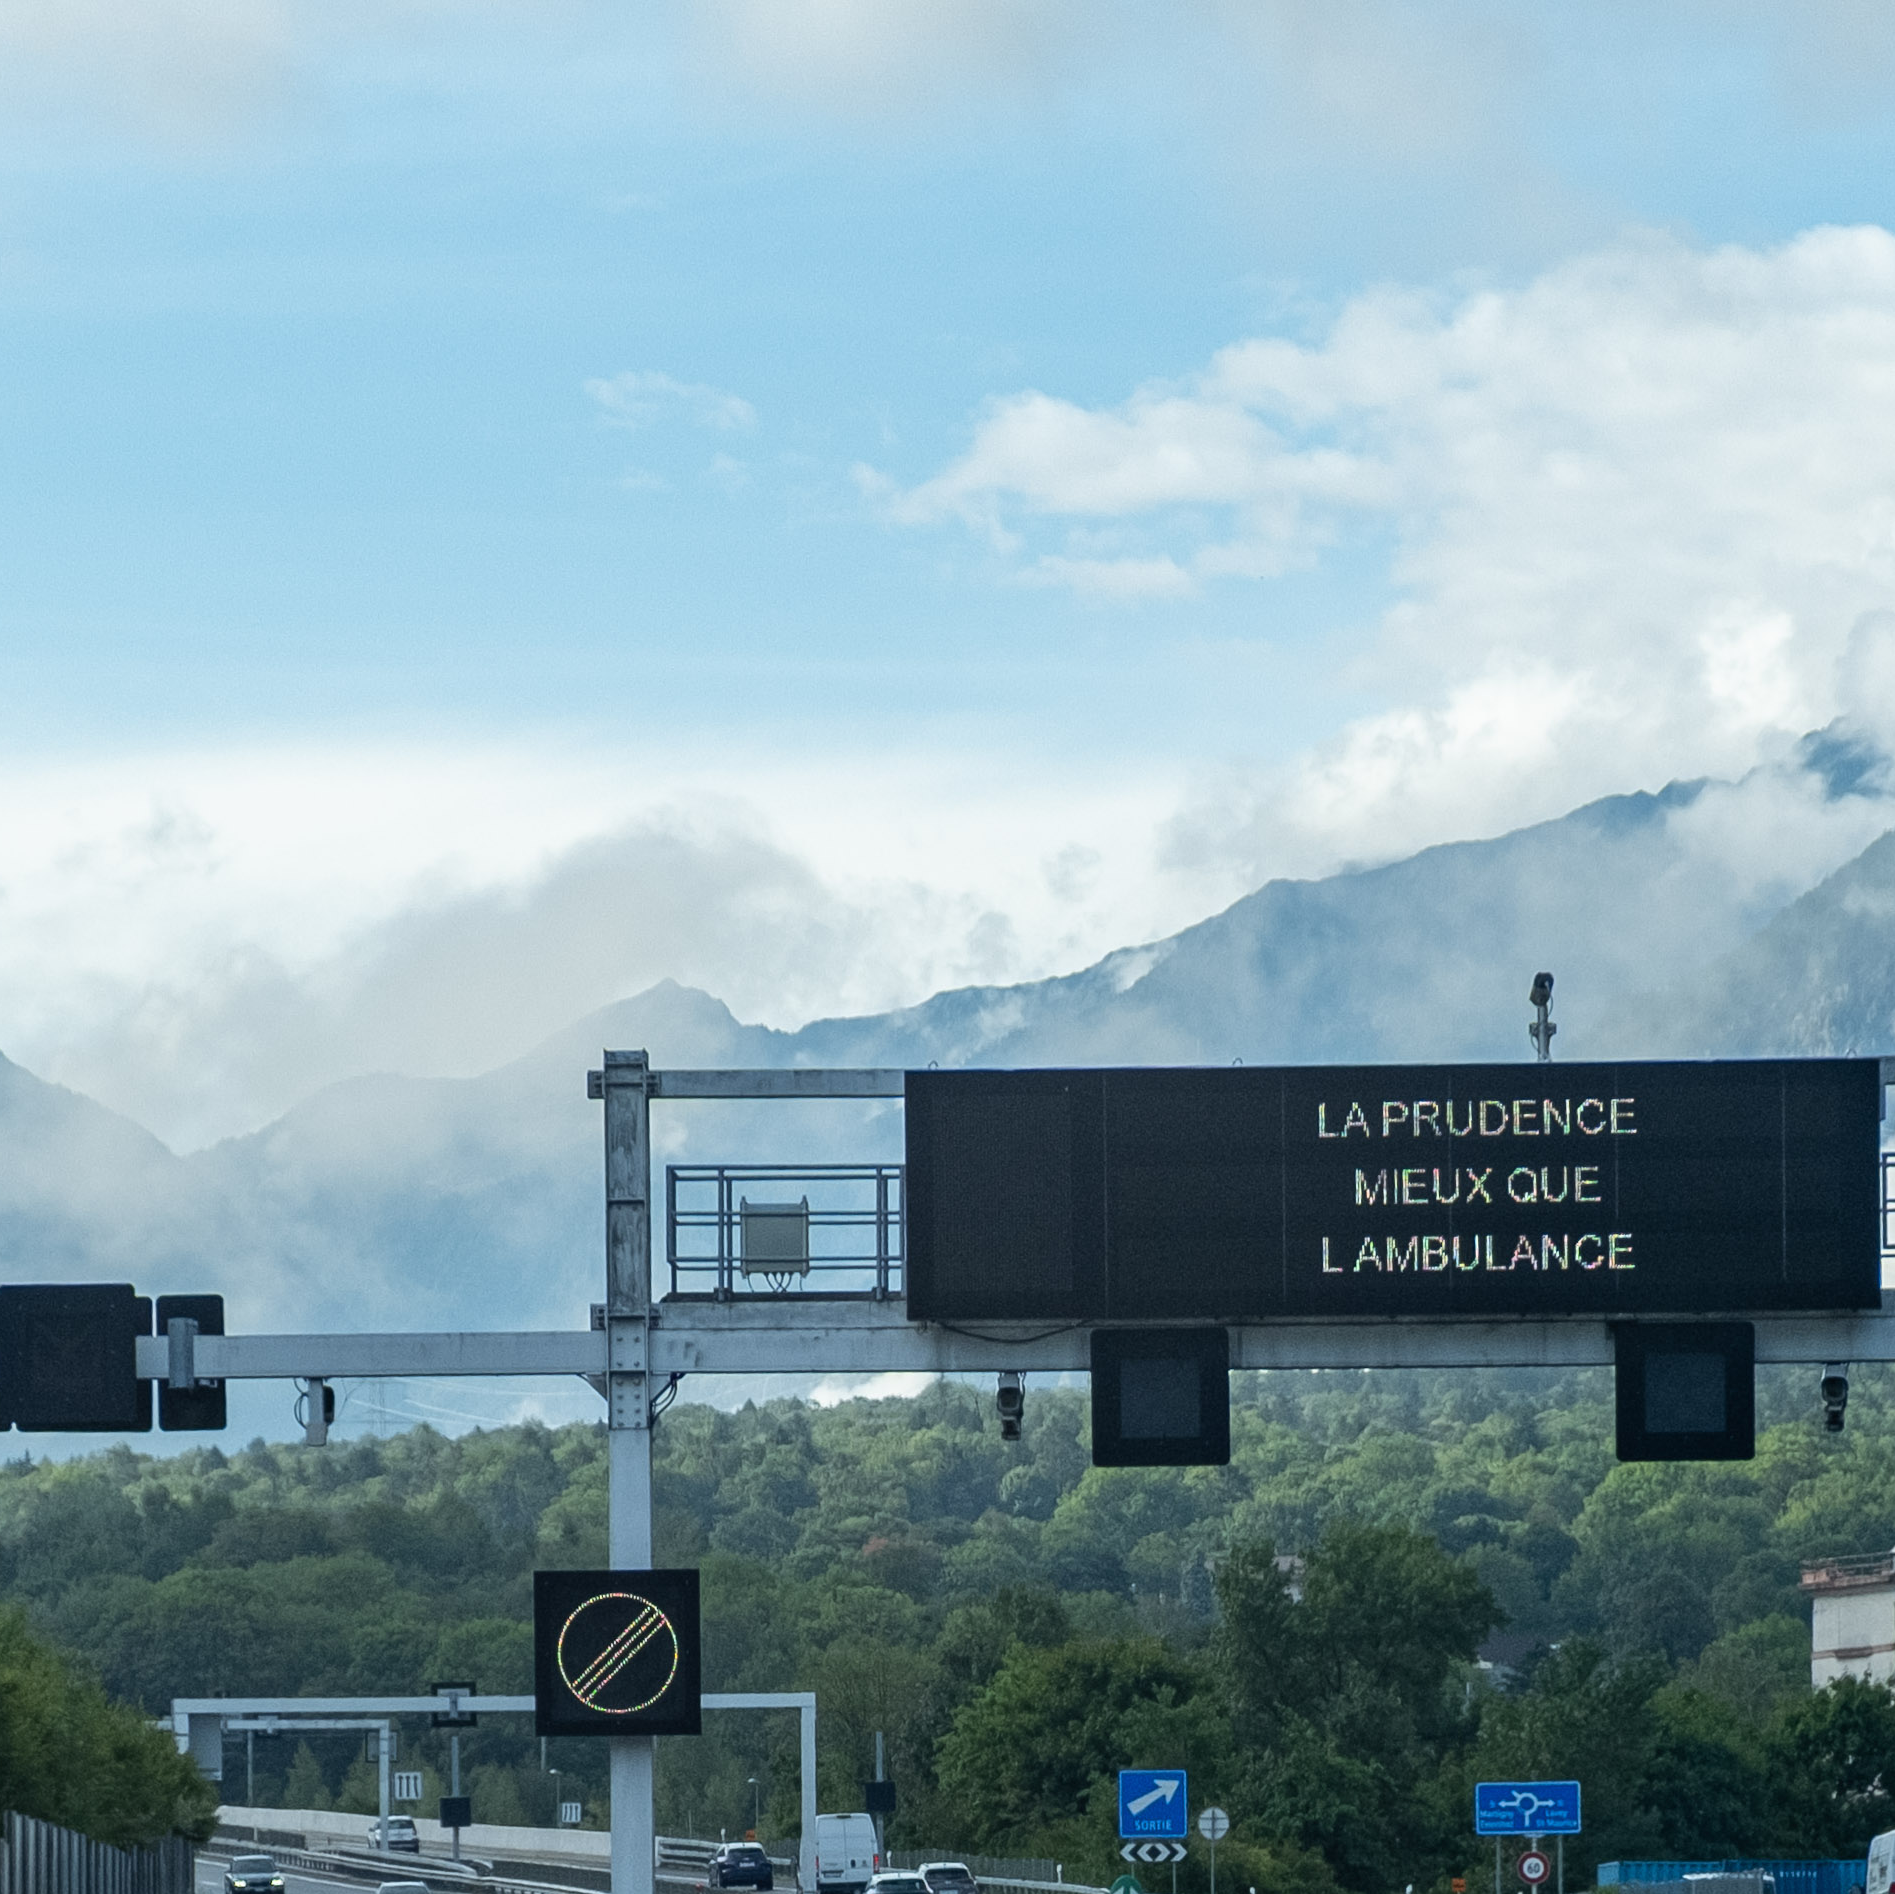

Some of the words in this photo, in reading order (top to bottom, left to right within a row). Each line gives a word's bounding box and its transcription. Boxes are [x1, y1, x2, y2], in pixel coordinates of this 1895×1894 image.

[1318, 1102, 1370, 1138] LA
[1382, 1098, 1638, 1137] PRUDENCE
[1355, 1167, 1493, 1205] MIEUX
[1508, 1166, 1602, 1203] QUE
[1134, 1820, 1173, 1831] SORTIE
[1527, 1862, 1541, 1874] 60
